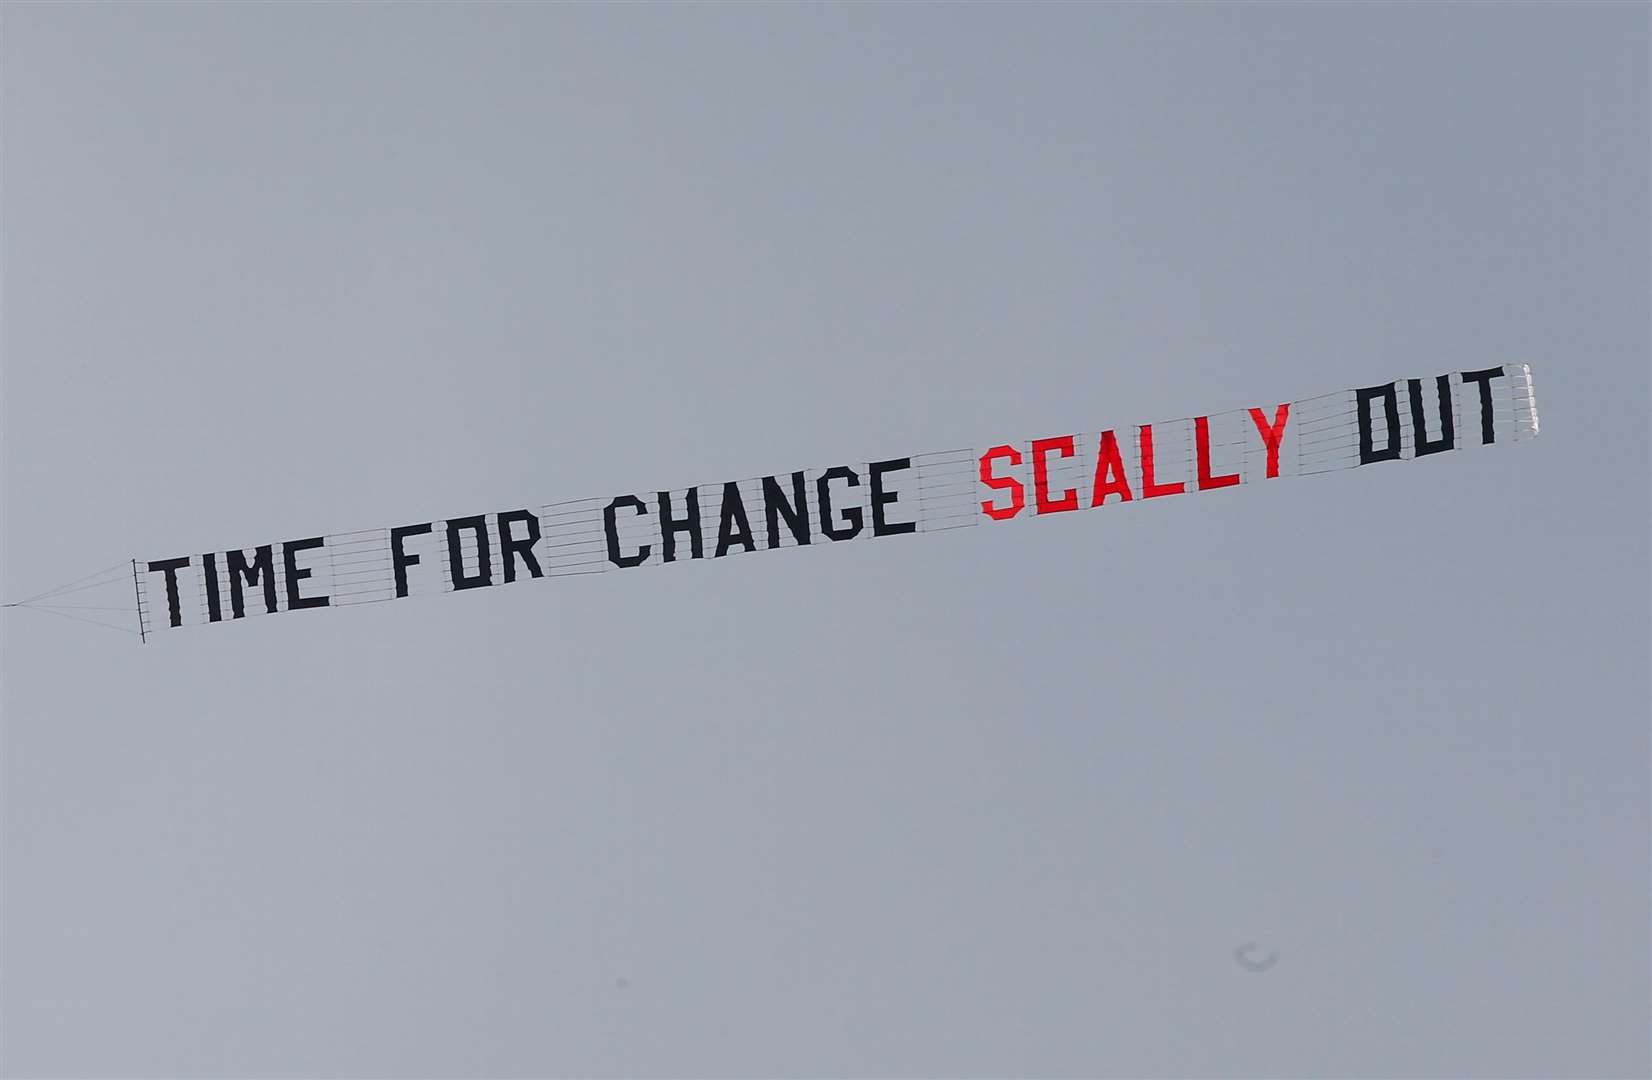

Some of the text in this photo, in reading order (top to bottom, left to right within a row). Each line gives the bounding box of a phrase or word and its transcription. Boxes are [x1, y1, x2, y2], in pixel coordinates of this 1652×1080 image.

[148, 366, 1505, 627] TIME FOR CHANGE SCALLY OUT
